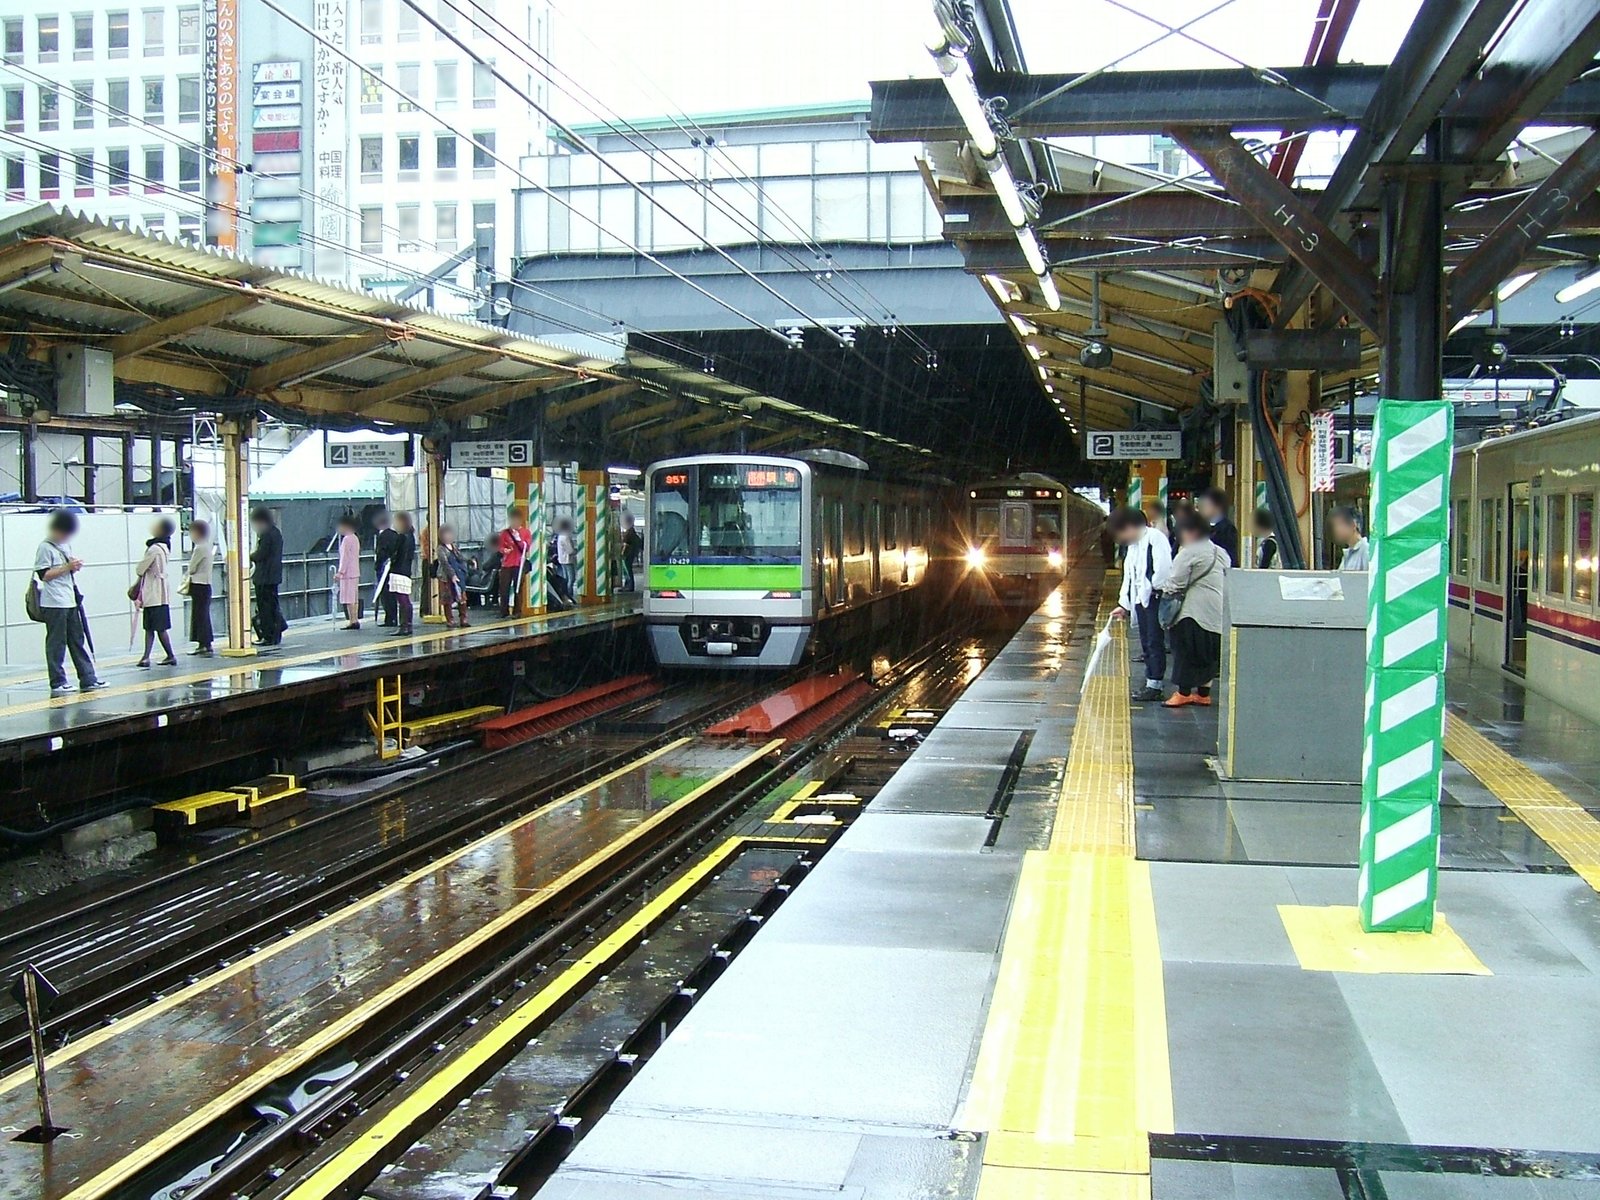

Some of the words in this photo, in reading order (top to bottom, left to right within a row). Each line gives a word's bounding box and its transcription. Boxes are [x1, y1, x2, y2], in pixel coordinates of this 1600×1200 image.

[218, 0, 234, 141] んの為にあるのです。
[1274, 204, 1319, 252] H-3
[1516, 188, 1570, 238] H-3
[332, 446, 347, 463] 4
[510, 445, 526, 462] 3
[1095, 436, 1112, 455] 2
